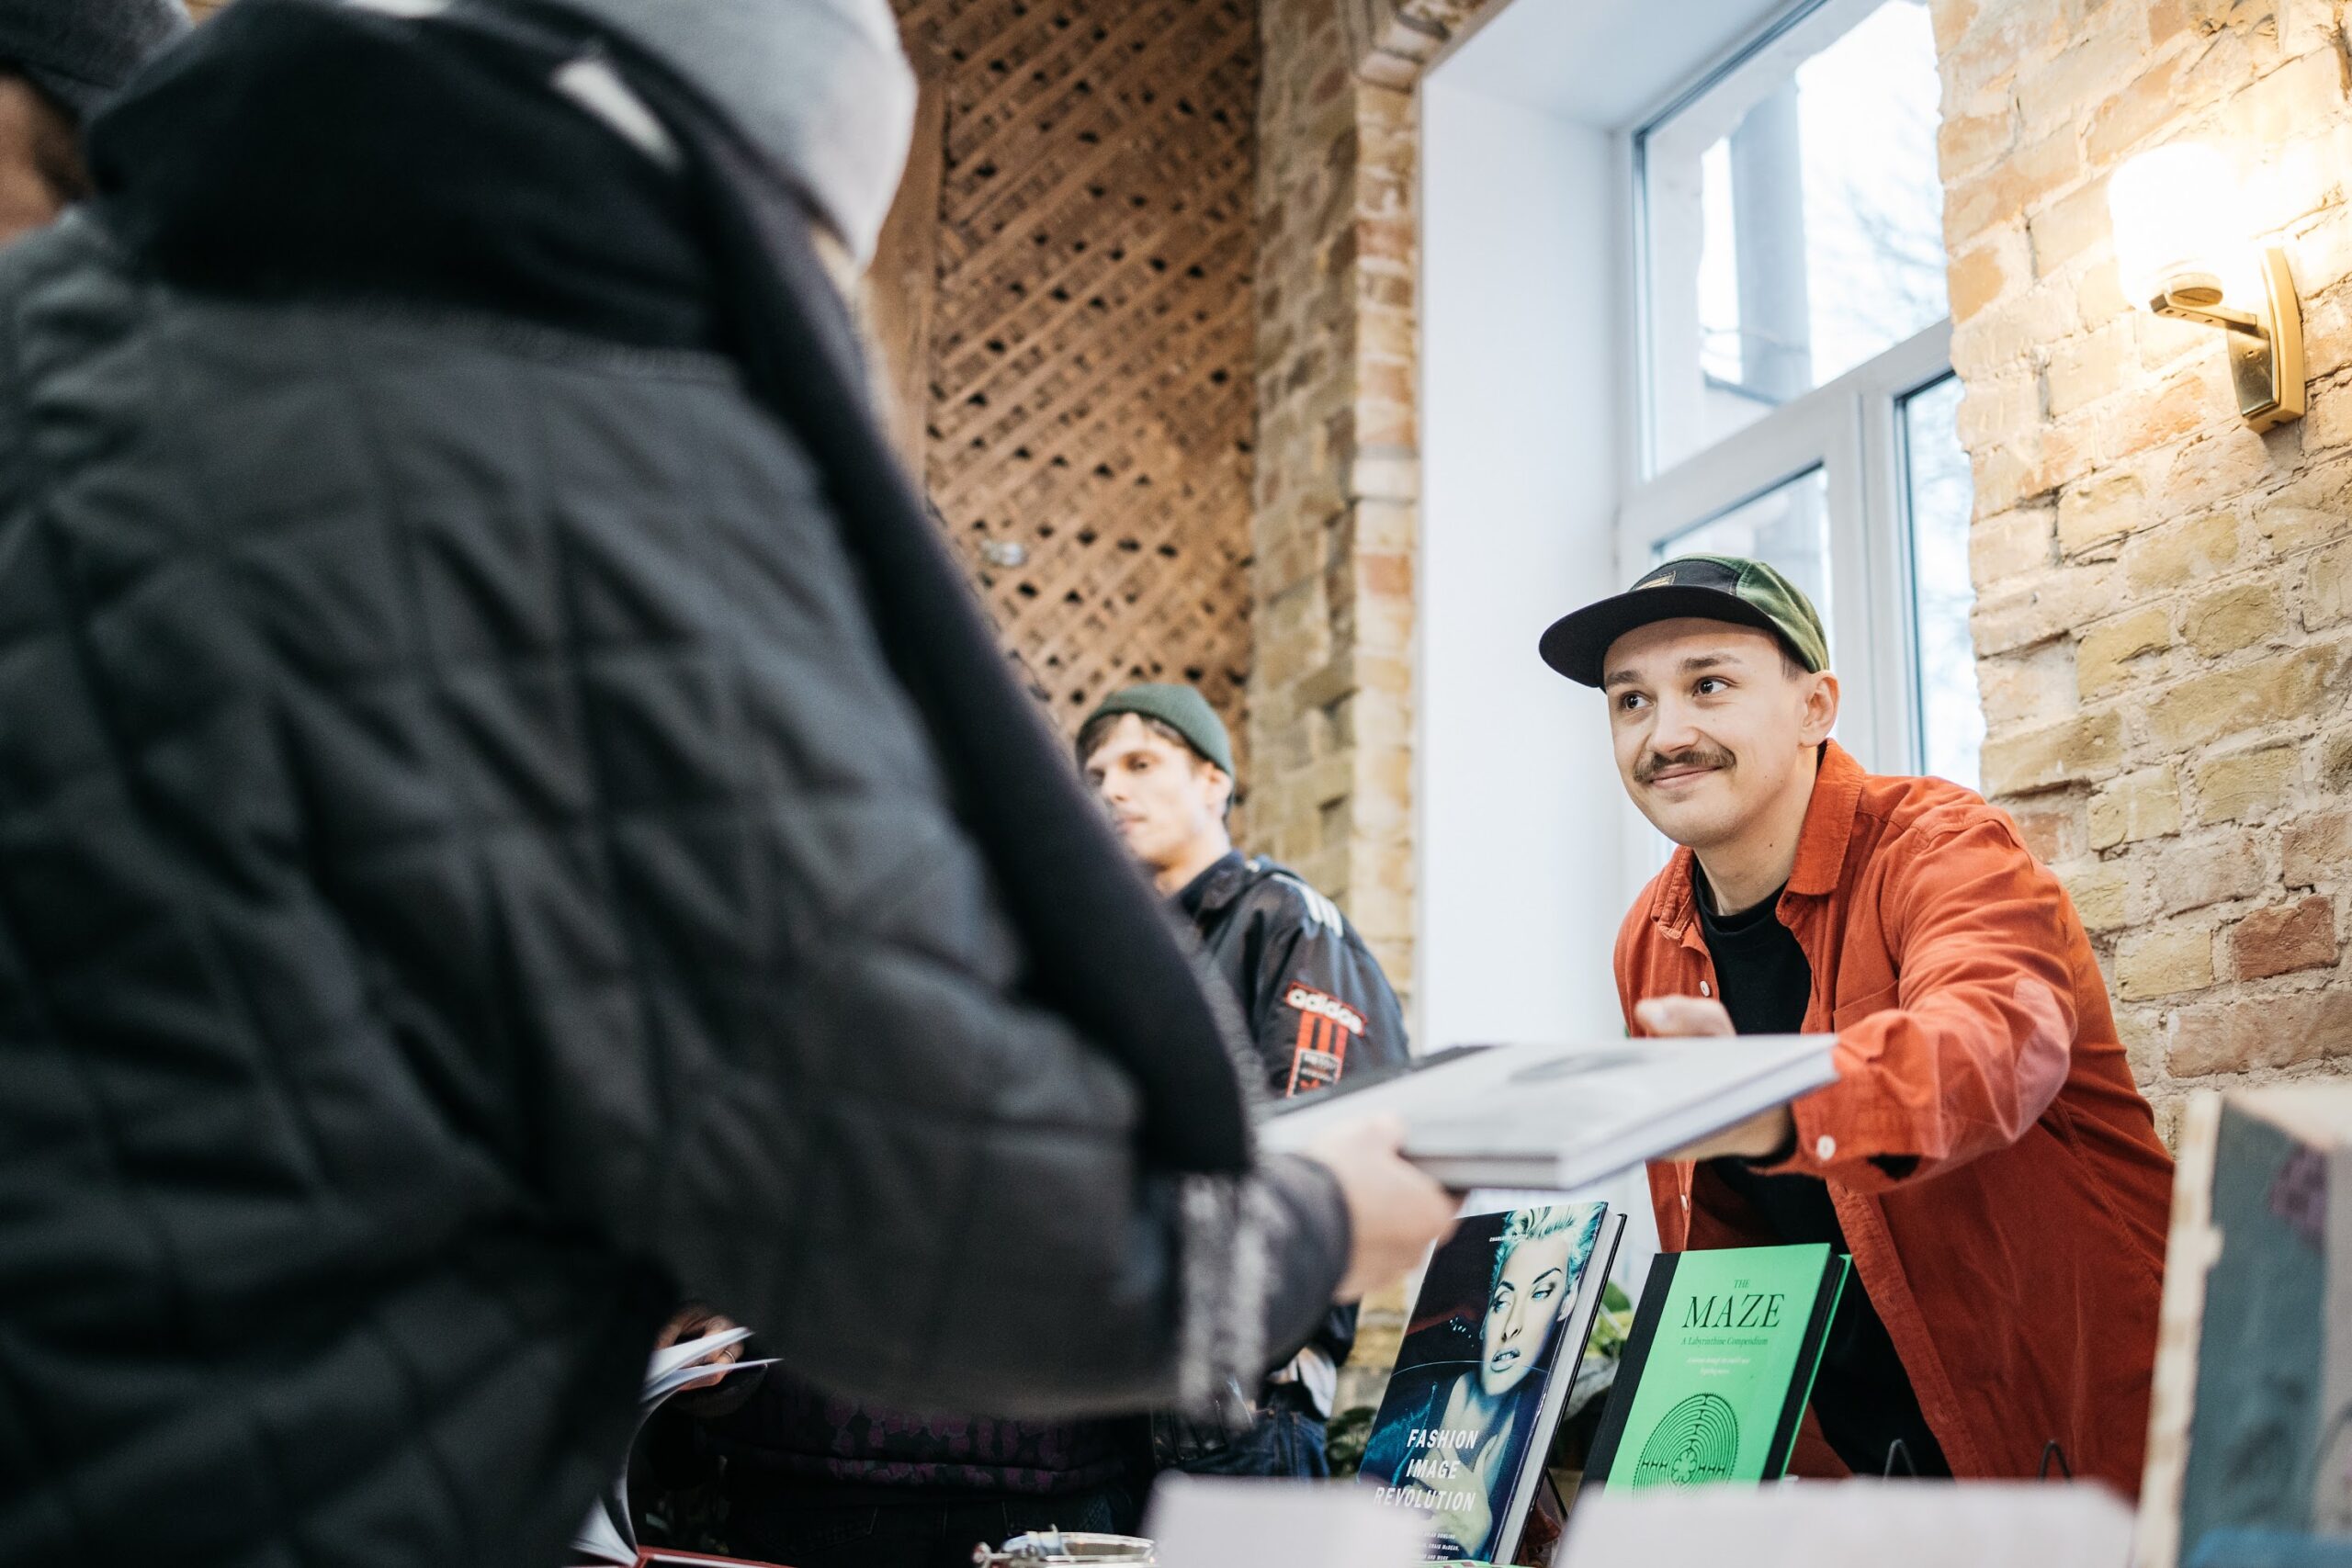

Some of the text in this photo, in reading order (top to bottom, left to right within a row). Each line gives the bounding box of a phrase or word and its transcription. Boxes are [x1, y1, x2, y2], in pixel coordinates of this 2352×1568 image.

[1289, 988, 1363, 1035] adidas
[1735, 1279, 1750, 1289] THE
[1681, 1293, 1785, 1328] MAZE
[1681, 1337, 1688, 1346] A
[1727, 1336, 1769, 1348] Compendium
[1407, 1428, 1479, 1450] FASHION
[1406, 1459, 1462, 1480] IMAGE
[1373, 1487, 1476, 1512] REVOLUTION
